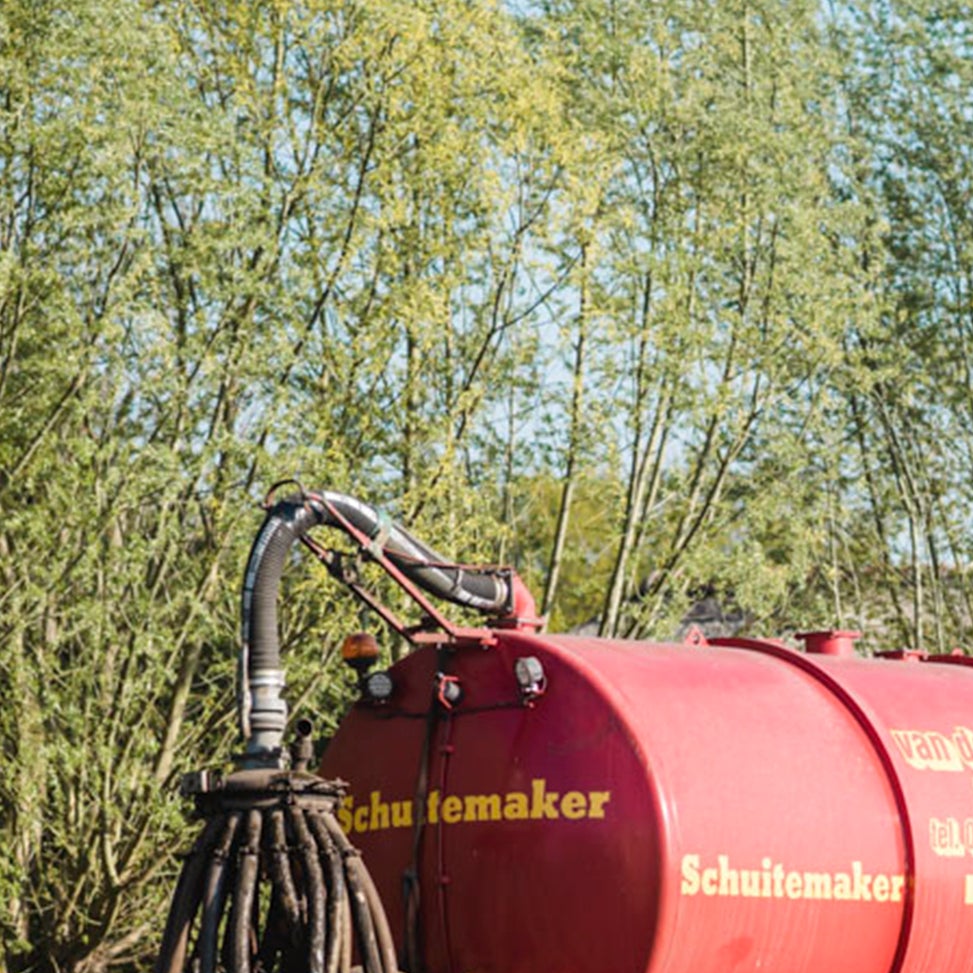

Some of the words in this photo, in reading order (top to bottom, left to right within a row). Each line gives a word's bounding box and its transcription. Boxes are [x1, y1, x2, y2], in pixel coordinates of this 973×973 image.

[890, 730, 964, 771] van
[338, 778, 610, 835] Schutemaker
[929, 817, 965, 857] tel.
[680, 854, 906, 902] Schuitemaker
